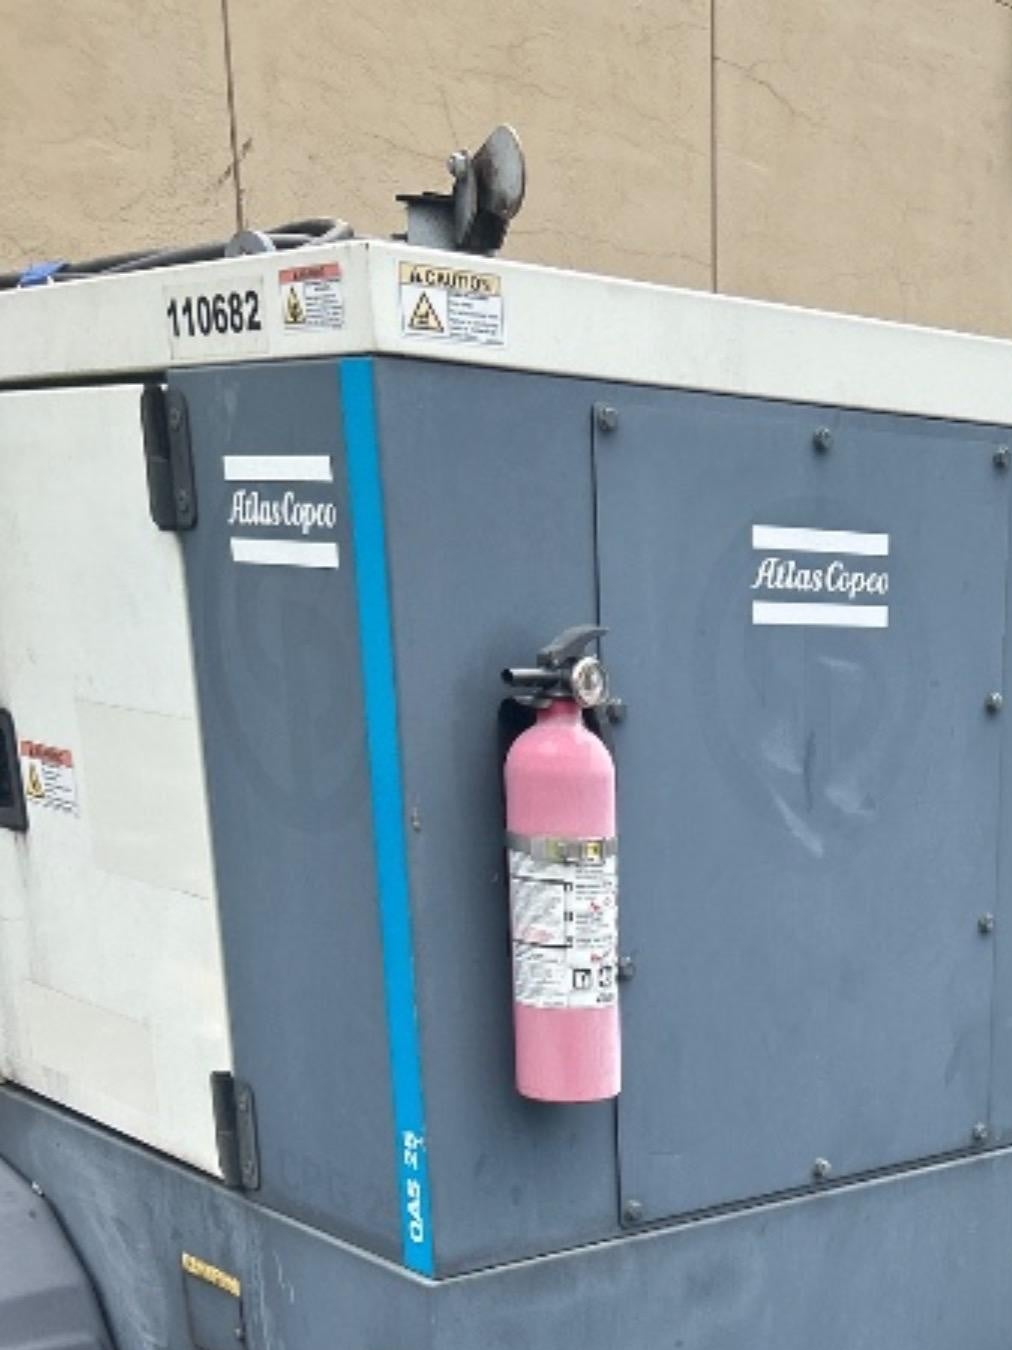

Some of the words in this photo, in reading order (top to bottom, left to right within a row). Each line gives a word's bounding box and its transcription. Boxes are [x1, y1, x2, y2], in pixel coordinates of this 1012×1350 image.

[167, 290, 262, 337] 110682
[227, 488, 280, 526] Atlas
[280, 490, 337, 535] Copco
[750, 557, 824, 592] Atlas
[825, 560, 889, 599] Copco
